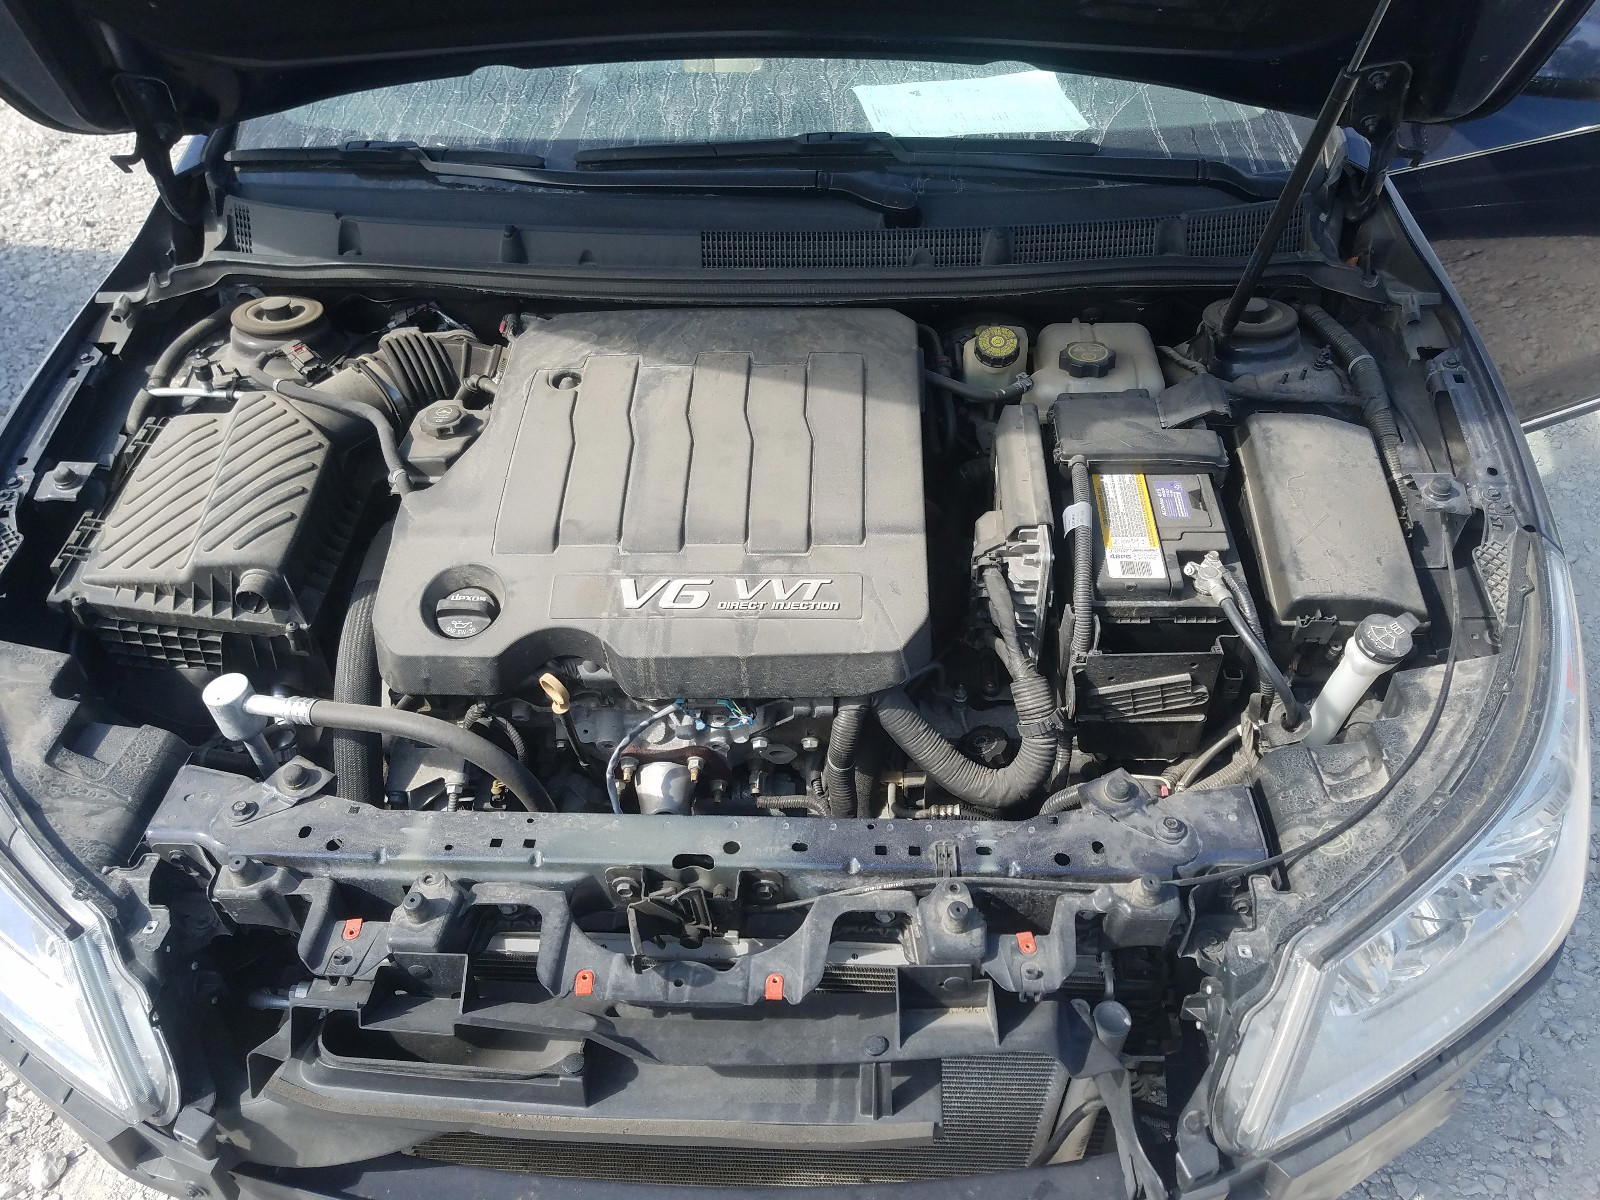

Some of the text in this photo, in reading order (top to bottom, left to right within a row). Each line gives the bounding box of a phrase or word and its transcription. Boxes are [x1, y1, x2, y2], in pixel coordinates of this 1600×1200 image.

[450, 594, 487, 602] dexos
[620, 578, 833, 609] V6 VVT
[717, 601, 841, 610] DIRECT INJECTION
